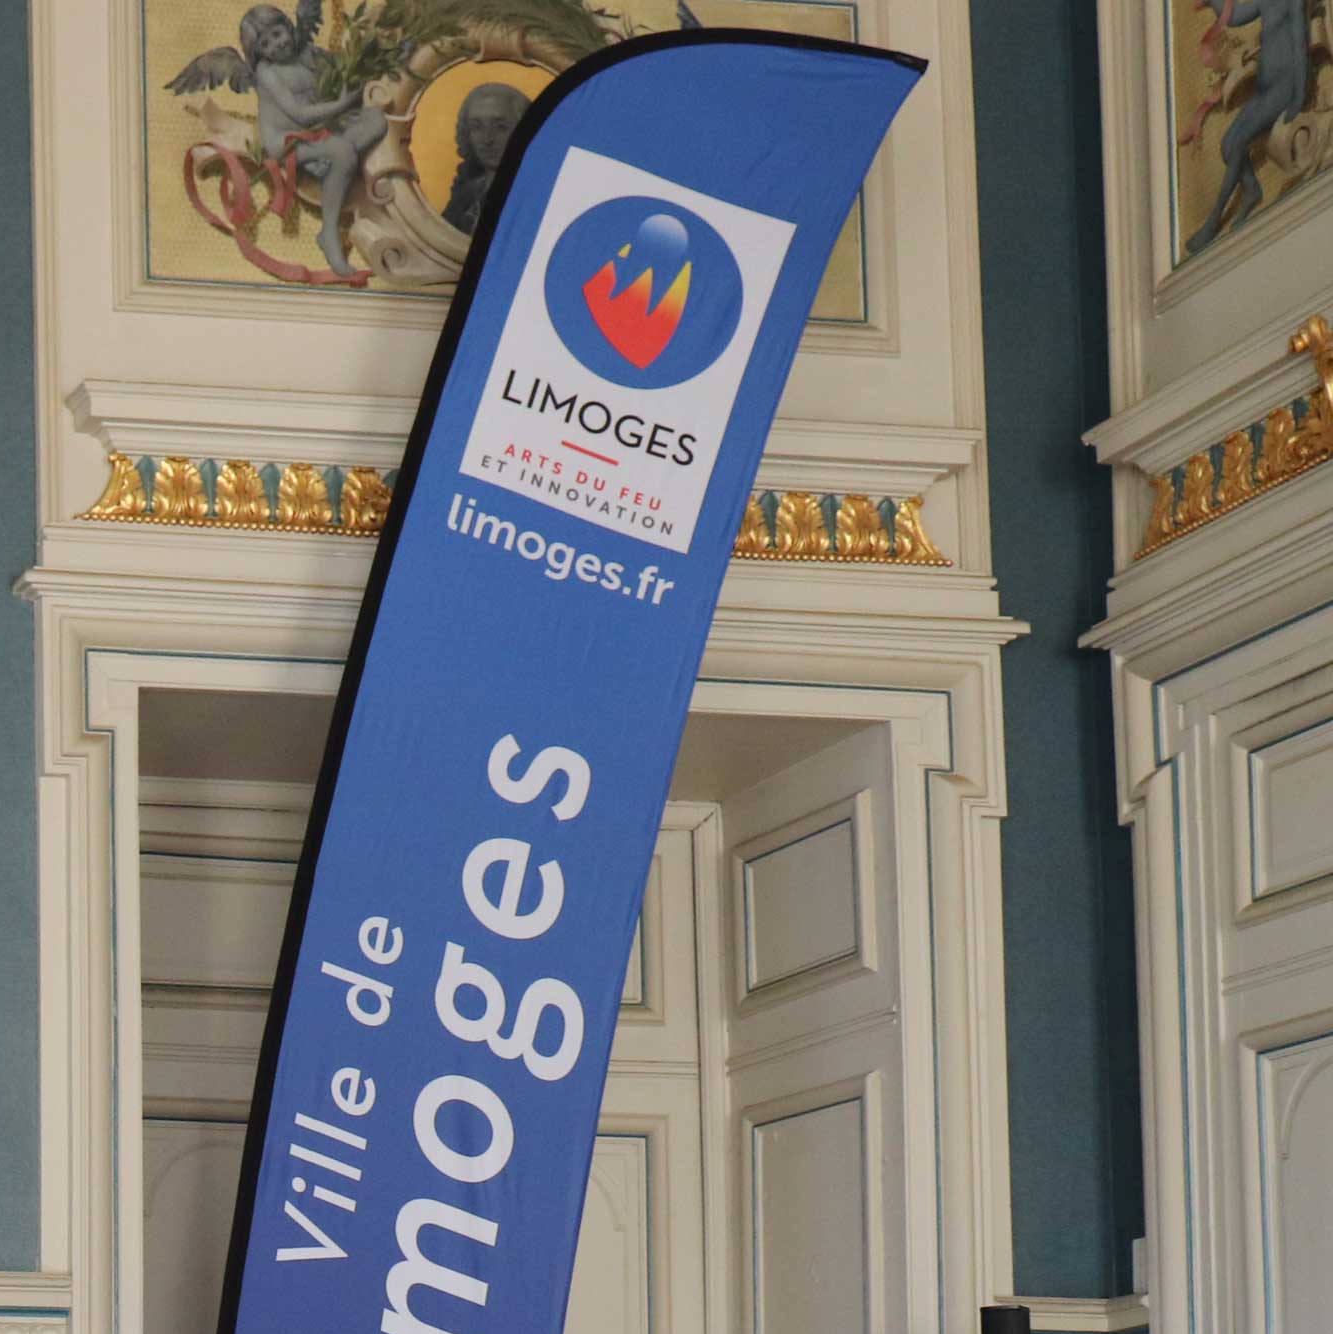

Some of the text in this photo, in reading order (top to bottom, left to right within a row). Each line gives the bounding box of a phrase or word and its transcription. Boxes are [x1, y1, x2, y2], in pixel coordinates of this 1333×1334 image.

[502, 369, 697, 466] LIMOGES
[481, 455, 674, 535] ET INNOVATION
[504, 443, 661, 511] ARTS DU FEU
[447, 493, 675, 606] limoges.fr
[275, 916, 404, 1262] Ville de
